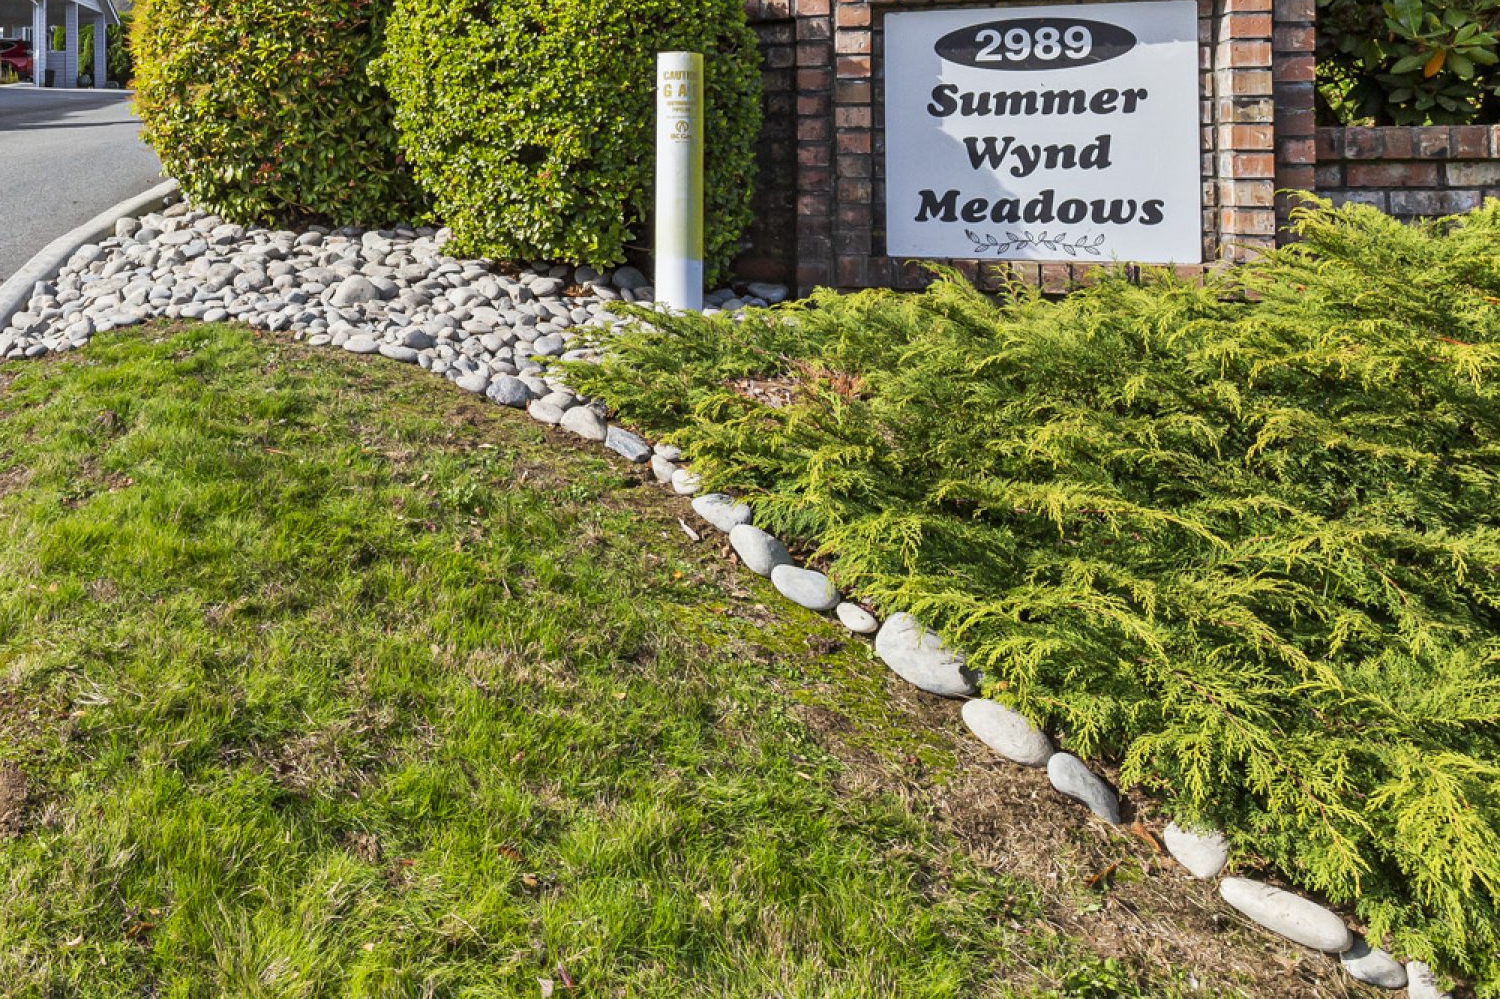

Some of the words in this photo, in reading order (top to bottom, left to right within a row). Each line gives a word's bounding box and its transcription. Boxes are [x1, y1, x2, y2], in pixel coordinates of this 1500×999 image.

[974, 25, 1093, 63] 2989
[927, 83, 1148, 118] Summer
[962, 134, 1111, 178] Wynd
[914, 188, 1165, 225] Meadows
